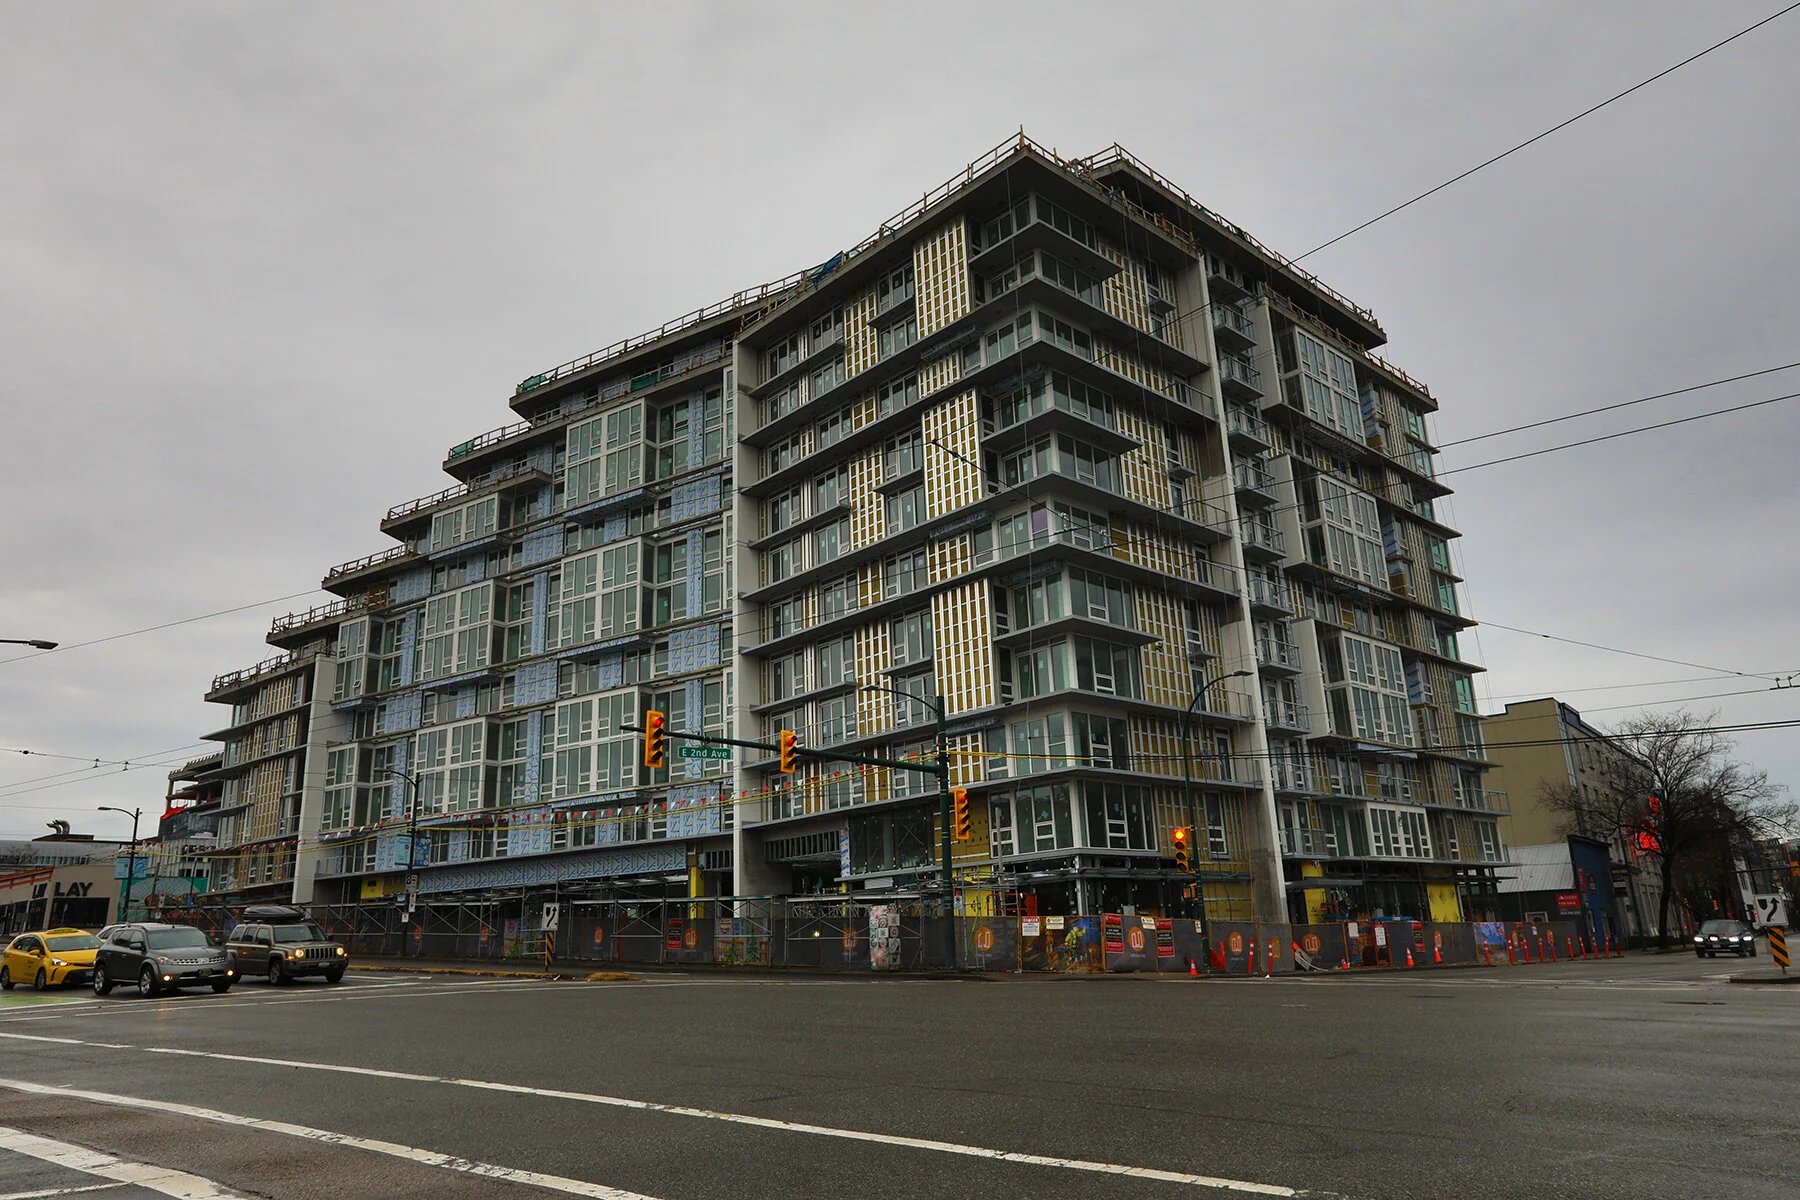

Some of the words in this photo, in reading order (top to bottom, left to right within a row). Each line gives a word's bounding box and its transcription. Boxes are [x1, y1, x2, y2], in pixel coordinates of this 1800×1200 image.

[682, 748, 687, 757] E
[690, 749, 707, 757] 2nd
[711, 750, 728, 758] Ave
[54, 881, 93, 897] LAY
